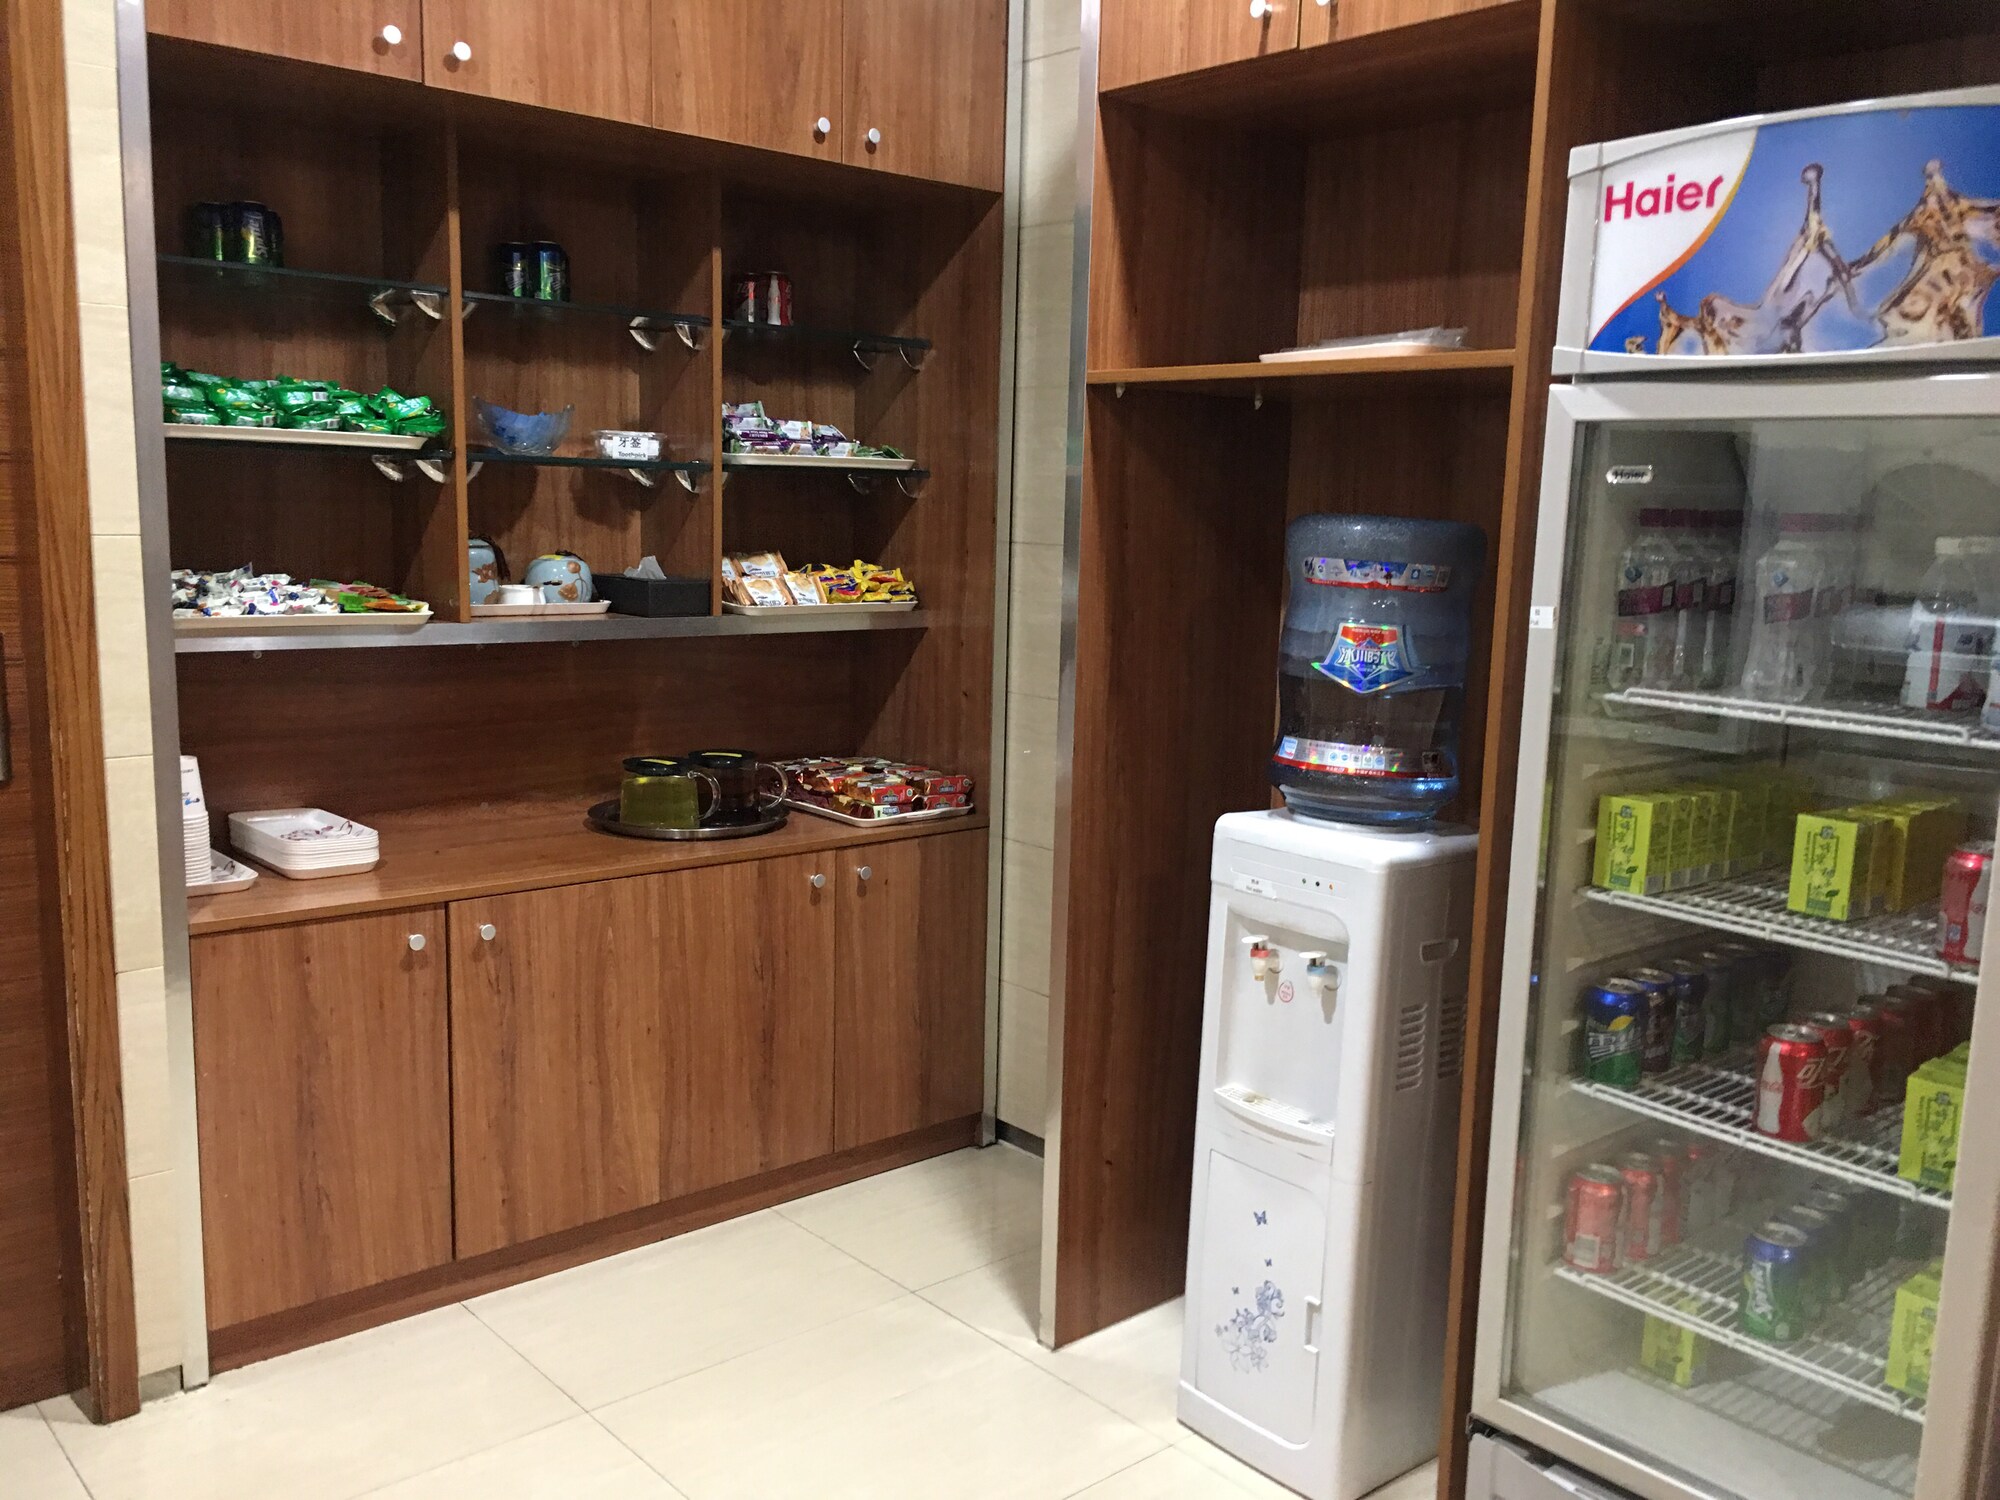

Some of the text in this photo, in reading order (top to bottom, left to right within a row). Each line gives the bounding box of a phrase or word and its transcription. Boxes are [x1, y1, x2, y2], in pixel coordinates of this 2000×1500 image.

[1604, 173, 1724, 222] Haier
[618, 436, 642, 449] 牙签
[618, 451, 647, 459] Toothpick
